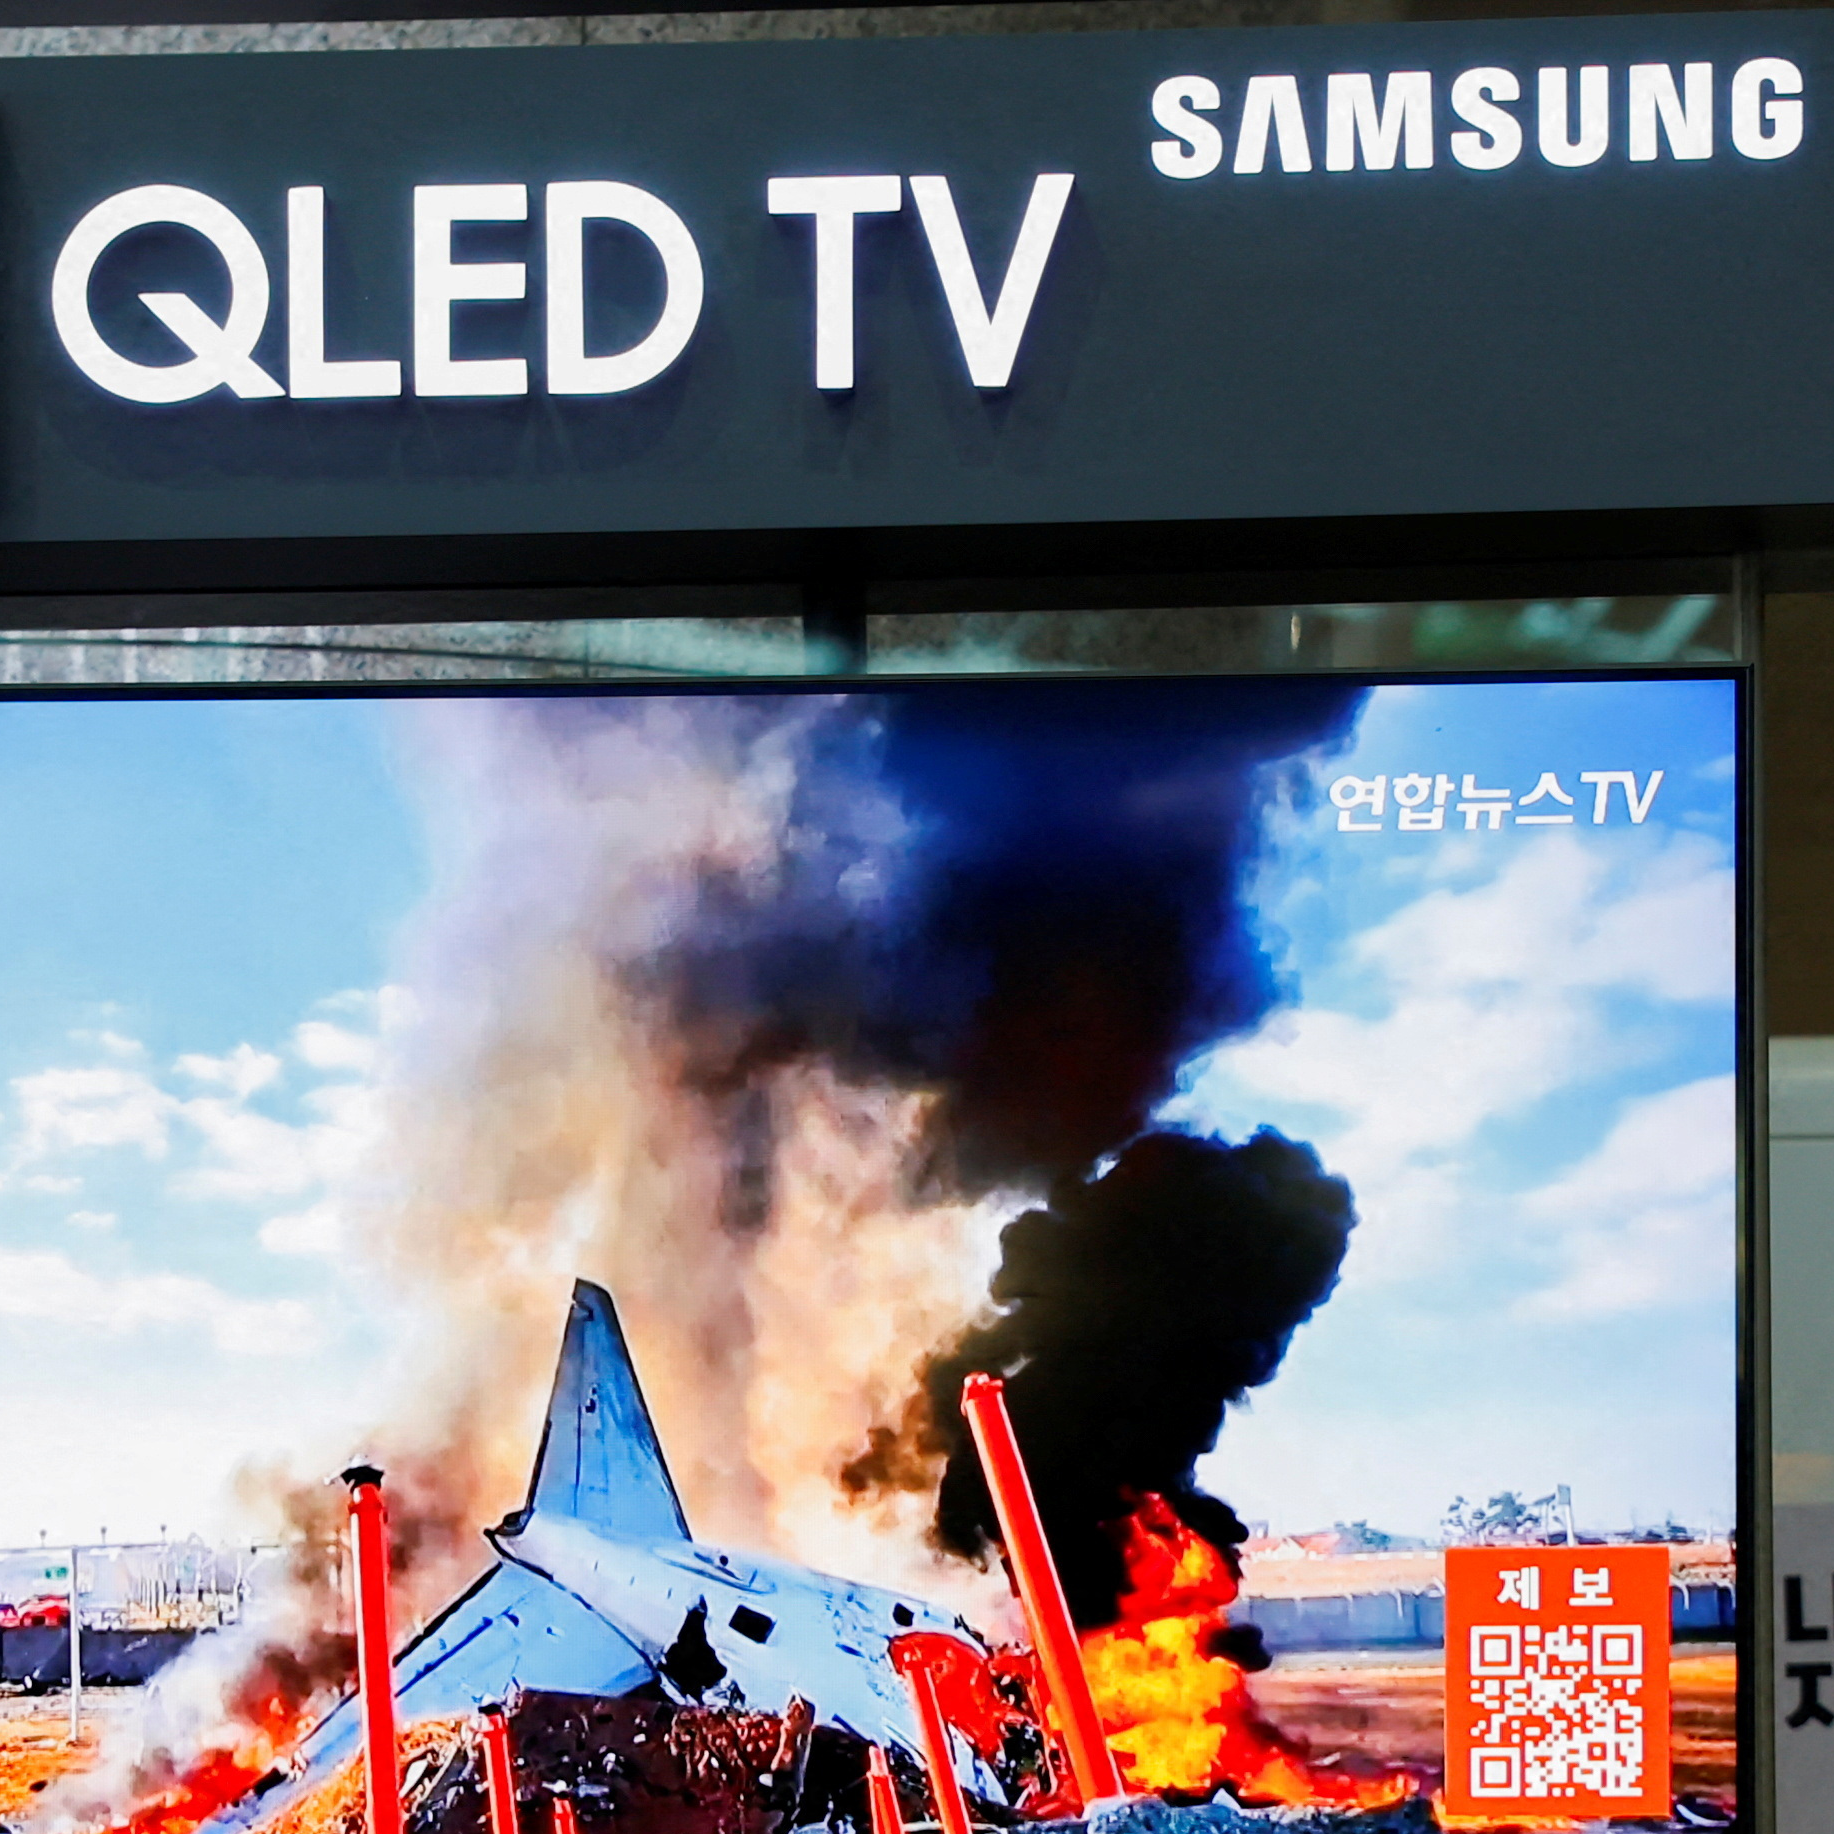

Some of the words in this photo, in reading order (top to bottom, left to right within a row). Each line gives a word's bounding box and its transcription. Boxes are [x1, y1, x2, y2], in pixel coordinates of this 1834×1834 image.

[1152, 58, 1803, 178] SAMSUNG
[52, 181, 703, 403] QLED
[768, 174, 1074, 388] TV
[1328, 769, 1664, 832] 연합뉴스TV
